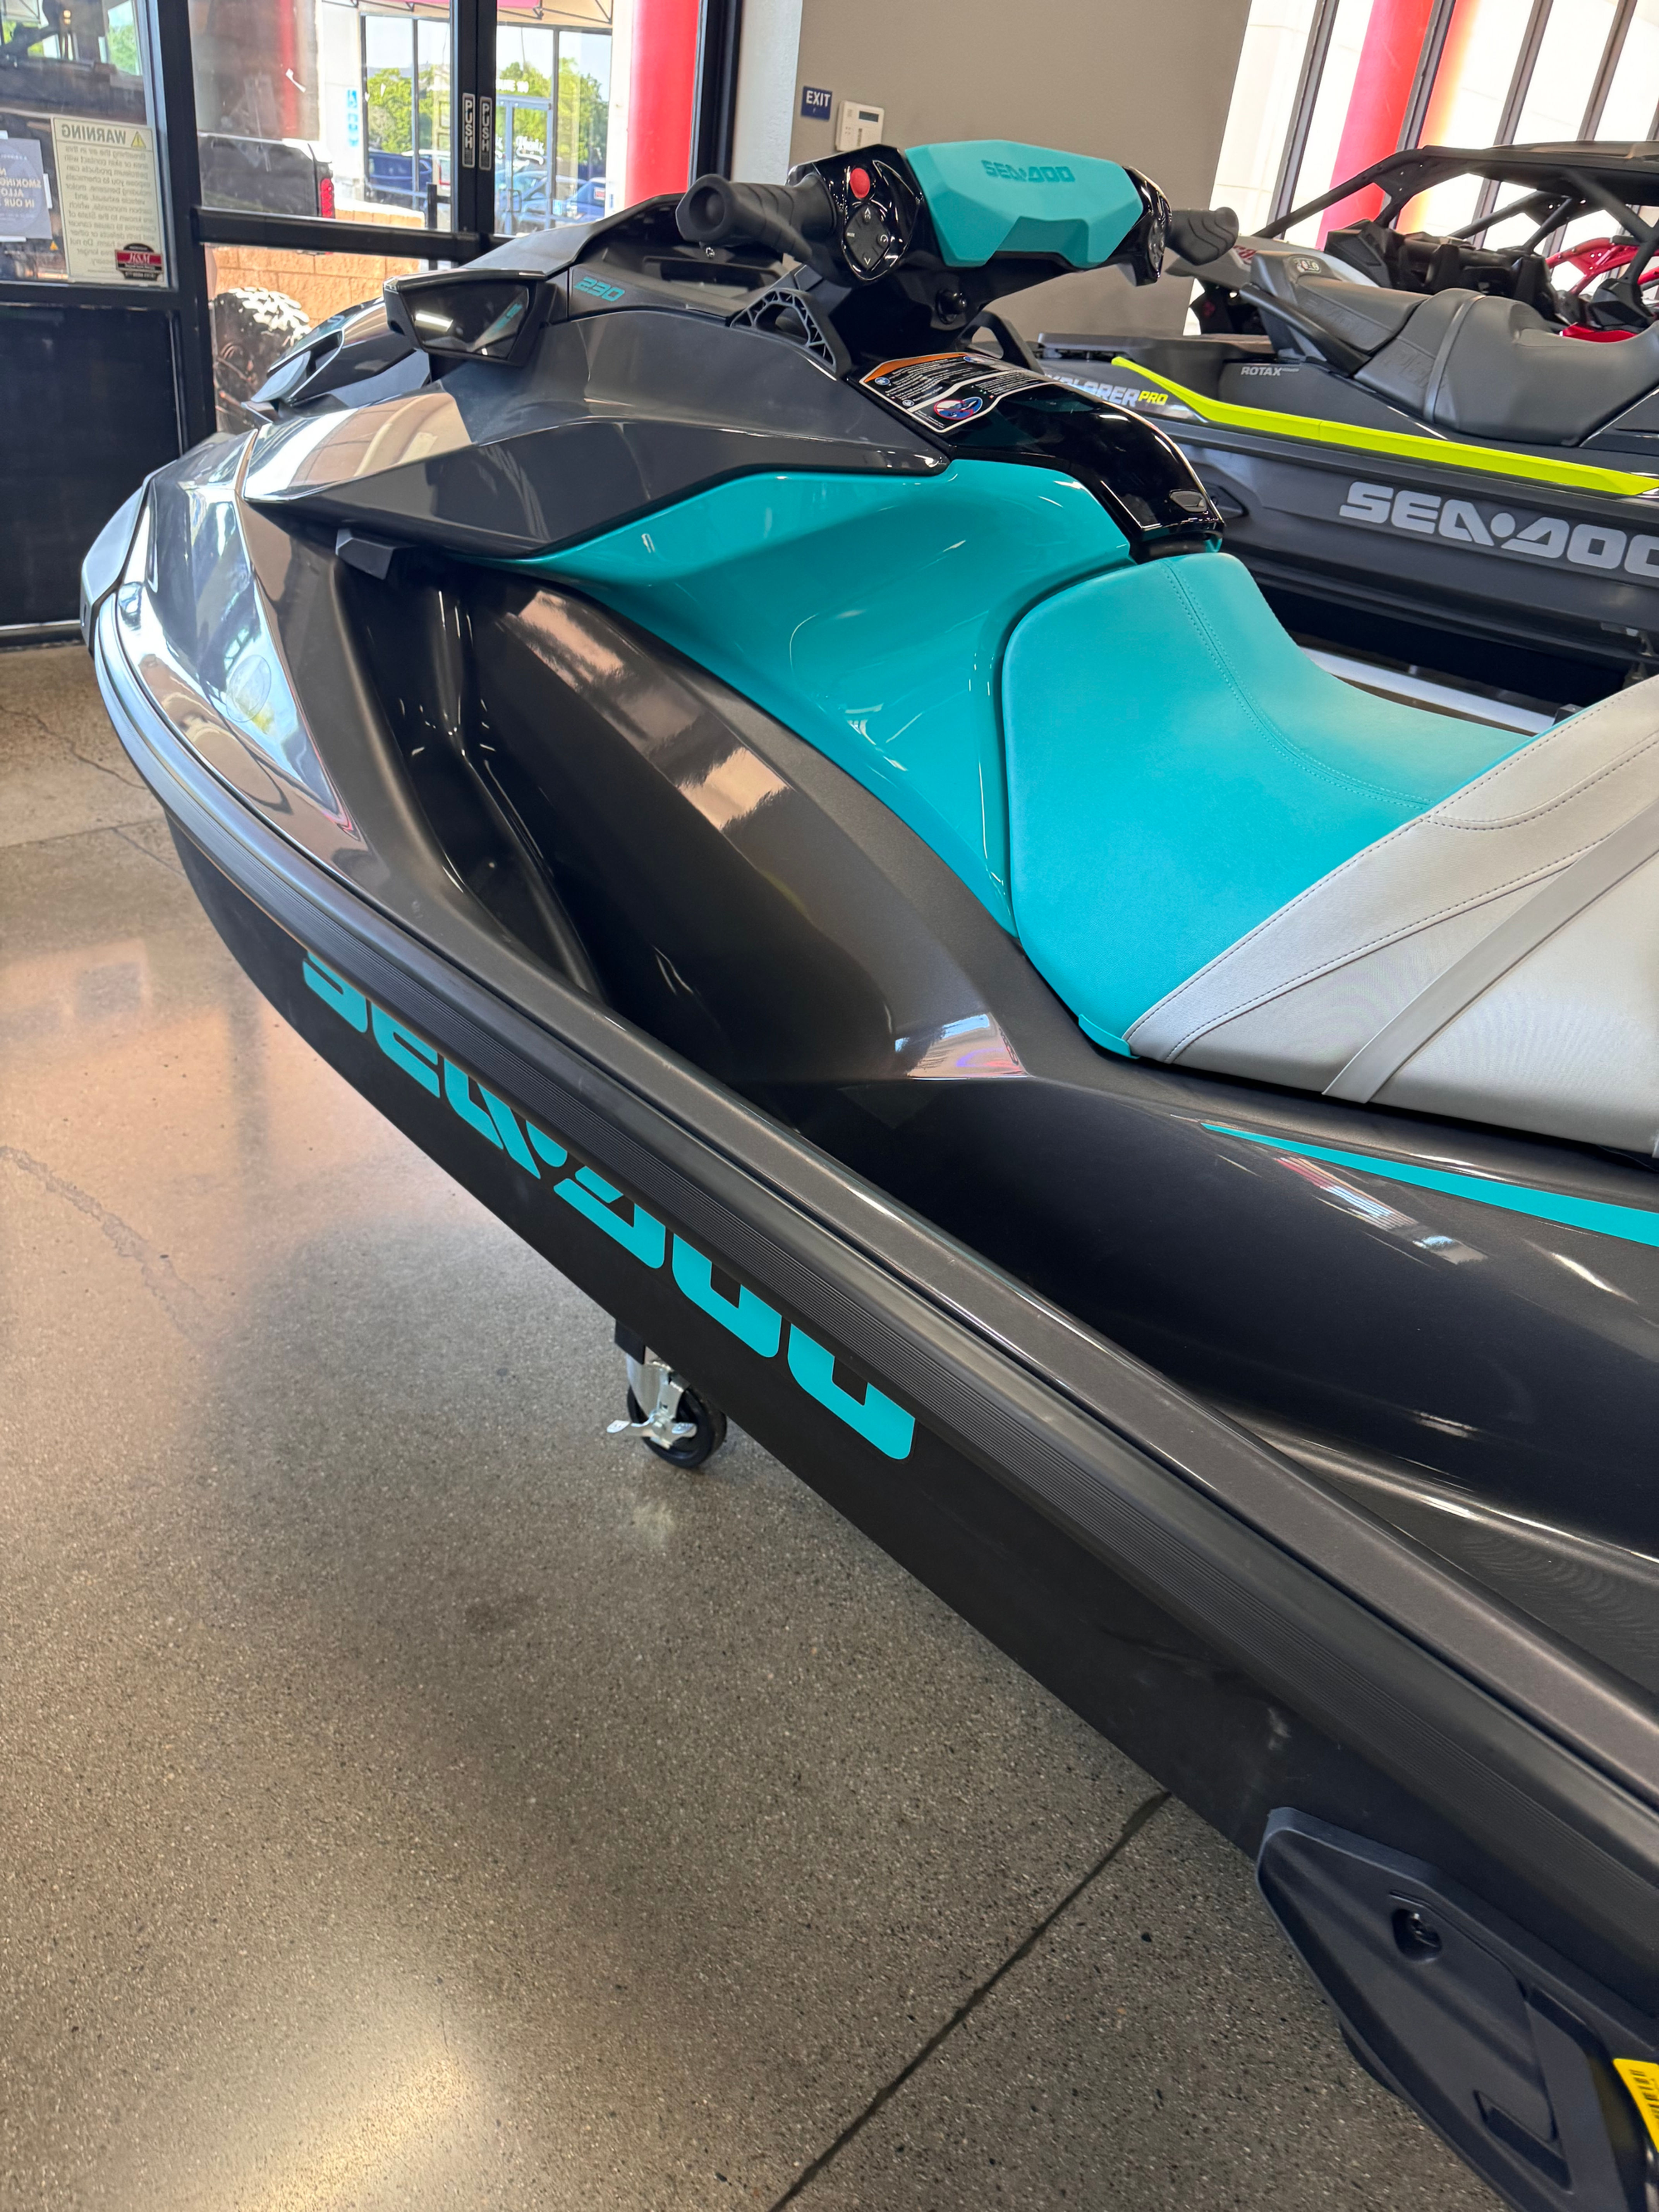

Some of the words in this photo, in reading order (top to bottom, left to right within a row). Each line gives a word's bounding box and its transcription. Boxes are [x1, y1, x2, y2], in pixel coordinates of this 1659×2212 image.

[806, 90, 830, 107] EXIT
[574, 276, 625, 302] 230
[1241, 366, 1282, 376] ROTAX
[1138, 390, 1168, 405] PRO
